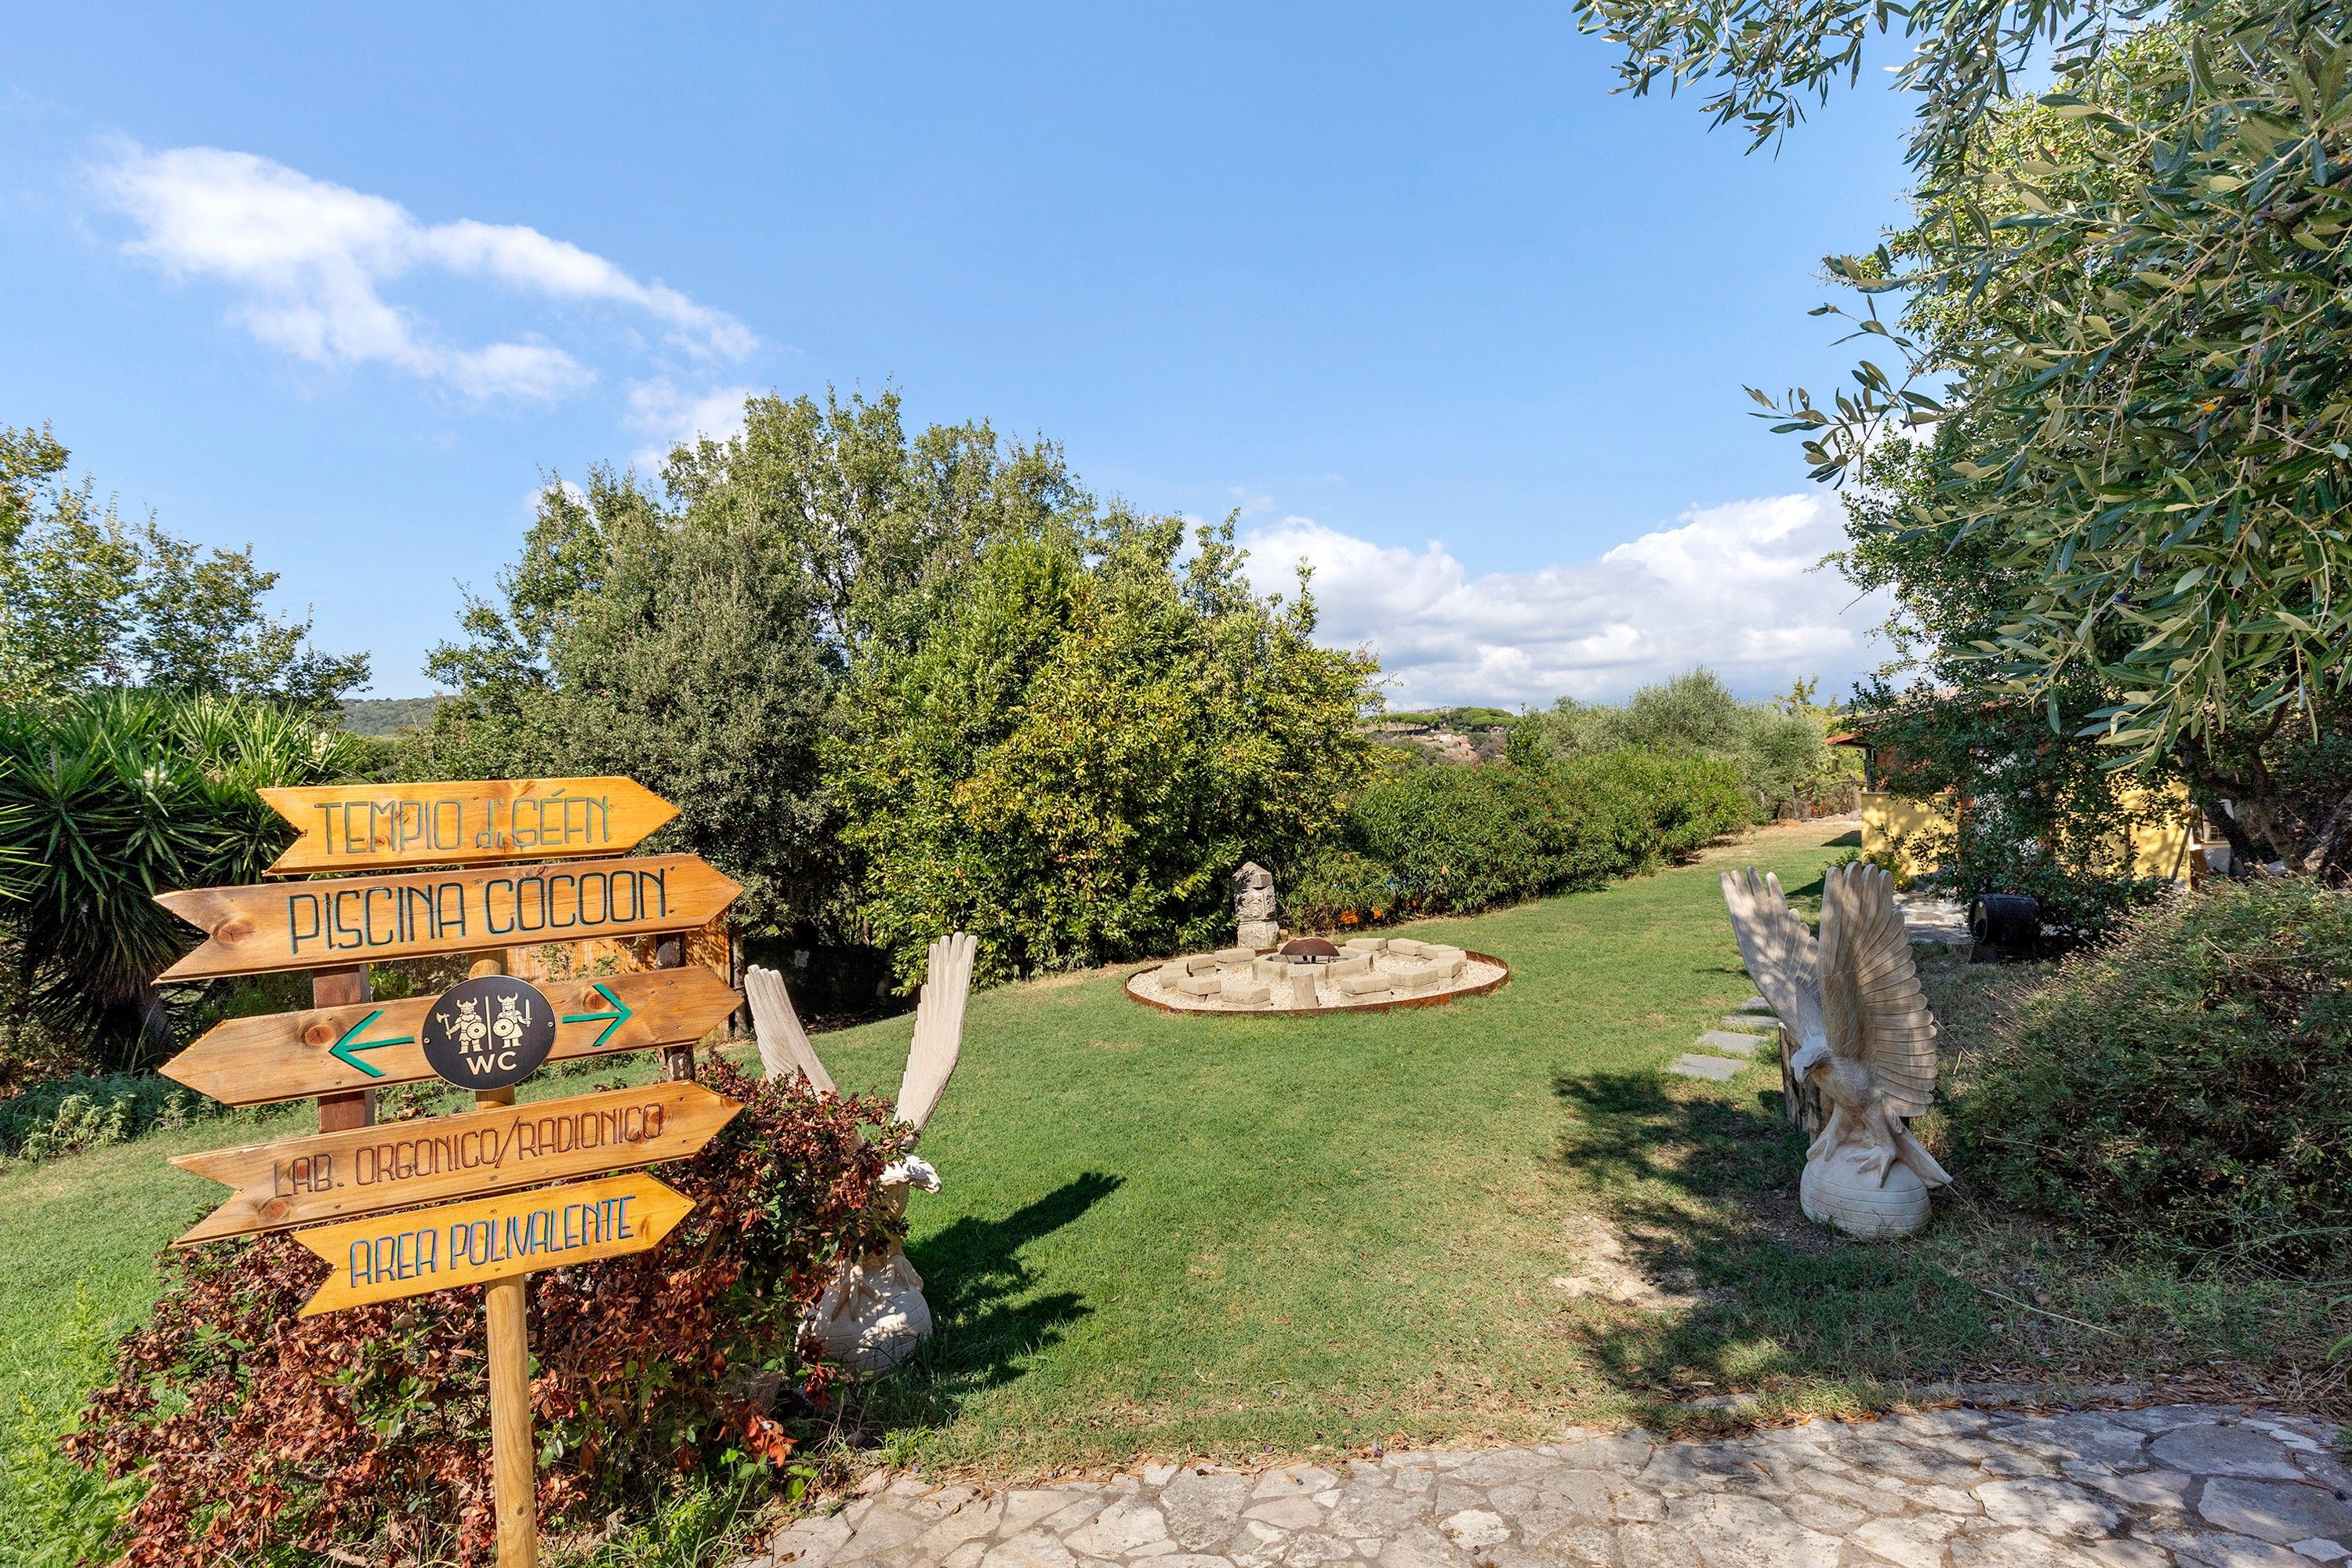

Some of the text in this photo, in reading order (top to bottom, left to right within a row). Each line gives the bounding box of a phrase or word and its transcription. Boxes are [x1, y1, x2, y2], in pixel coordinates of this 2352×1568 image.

[314, 799, 462, 855] TEMPIO
[476, 798, 505, 848] di
[288, 869, 666, 956] PISCINA COCOON
[466, 1051, 517, 1076] WC
[274, 1103, 664, 1198] LAB. ORGONICO/RADIONICO
[350, 1195, 637, 1287] AREA POLIVALENTE
